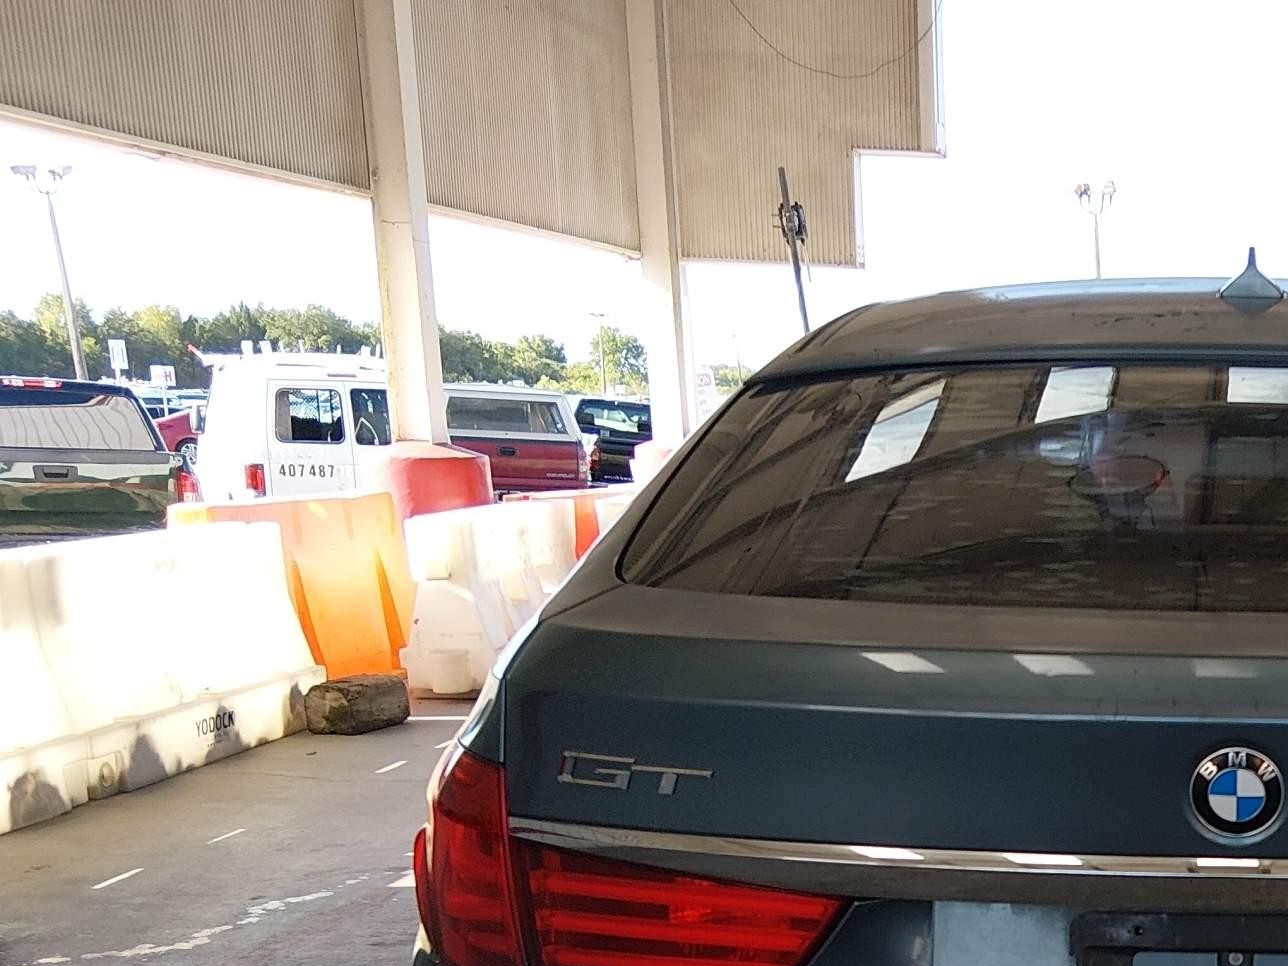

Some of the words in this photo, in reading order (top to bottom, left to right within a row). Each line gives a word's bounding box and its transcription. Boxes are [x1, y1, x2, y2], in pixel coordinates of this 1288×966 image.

[279, 463, 335, 478] 407487
[195, 710, 235, 738] YODOCK
[556, 750, 714, 795] GT
[1199, 751, 1277, 782] BMW
